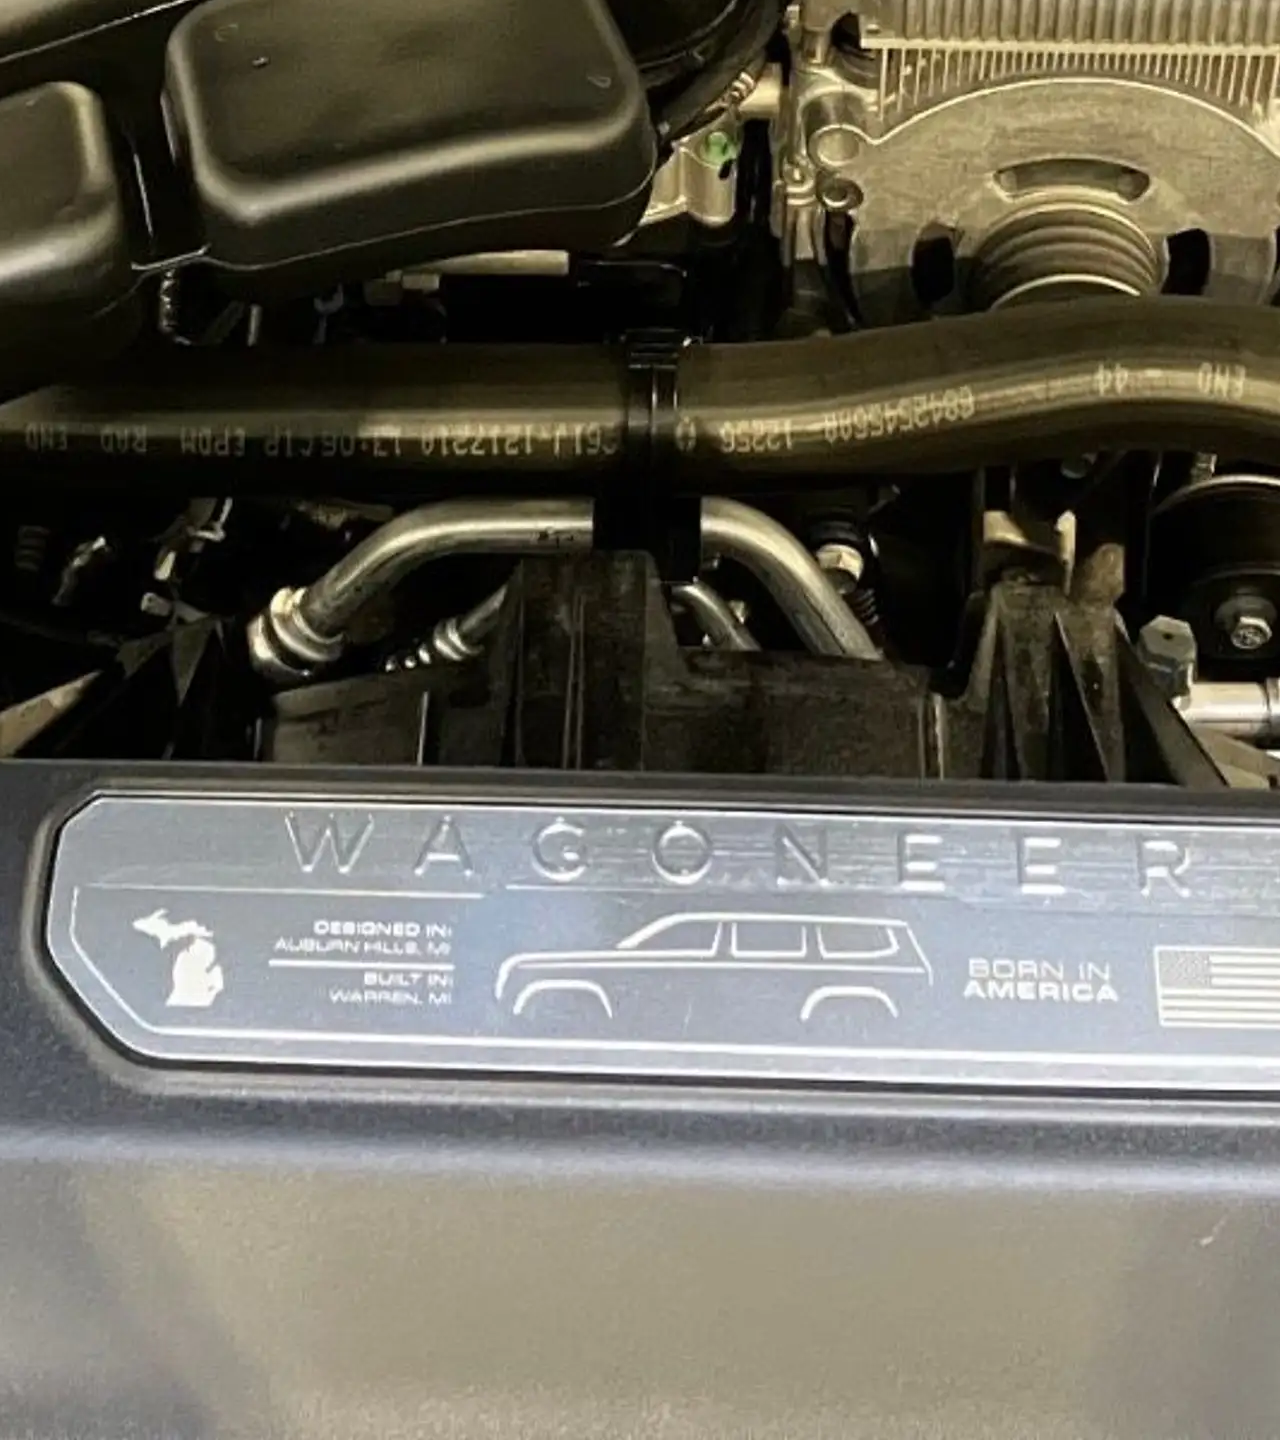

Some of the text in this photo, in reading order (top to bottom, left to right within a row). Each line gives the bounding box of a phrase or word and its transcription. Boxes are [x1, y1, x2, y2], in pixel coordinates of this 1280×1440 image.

[1197, 361, 1247, 402] END
[24, 423, 69, 453] END
[99, 424, 149, 454] RAD
[179, 426, 248, 458] EPDM
[284, 812, 1196, 899] WAGONEER
[273, 936, 361, 954] AUBURN
[363, 971, 424, 987] BUILT
[968, 957, 1111, 982] BORN IN
[428, 991, 452, 1006] MI
[962, 978, 1120, 1004] AMERICA
